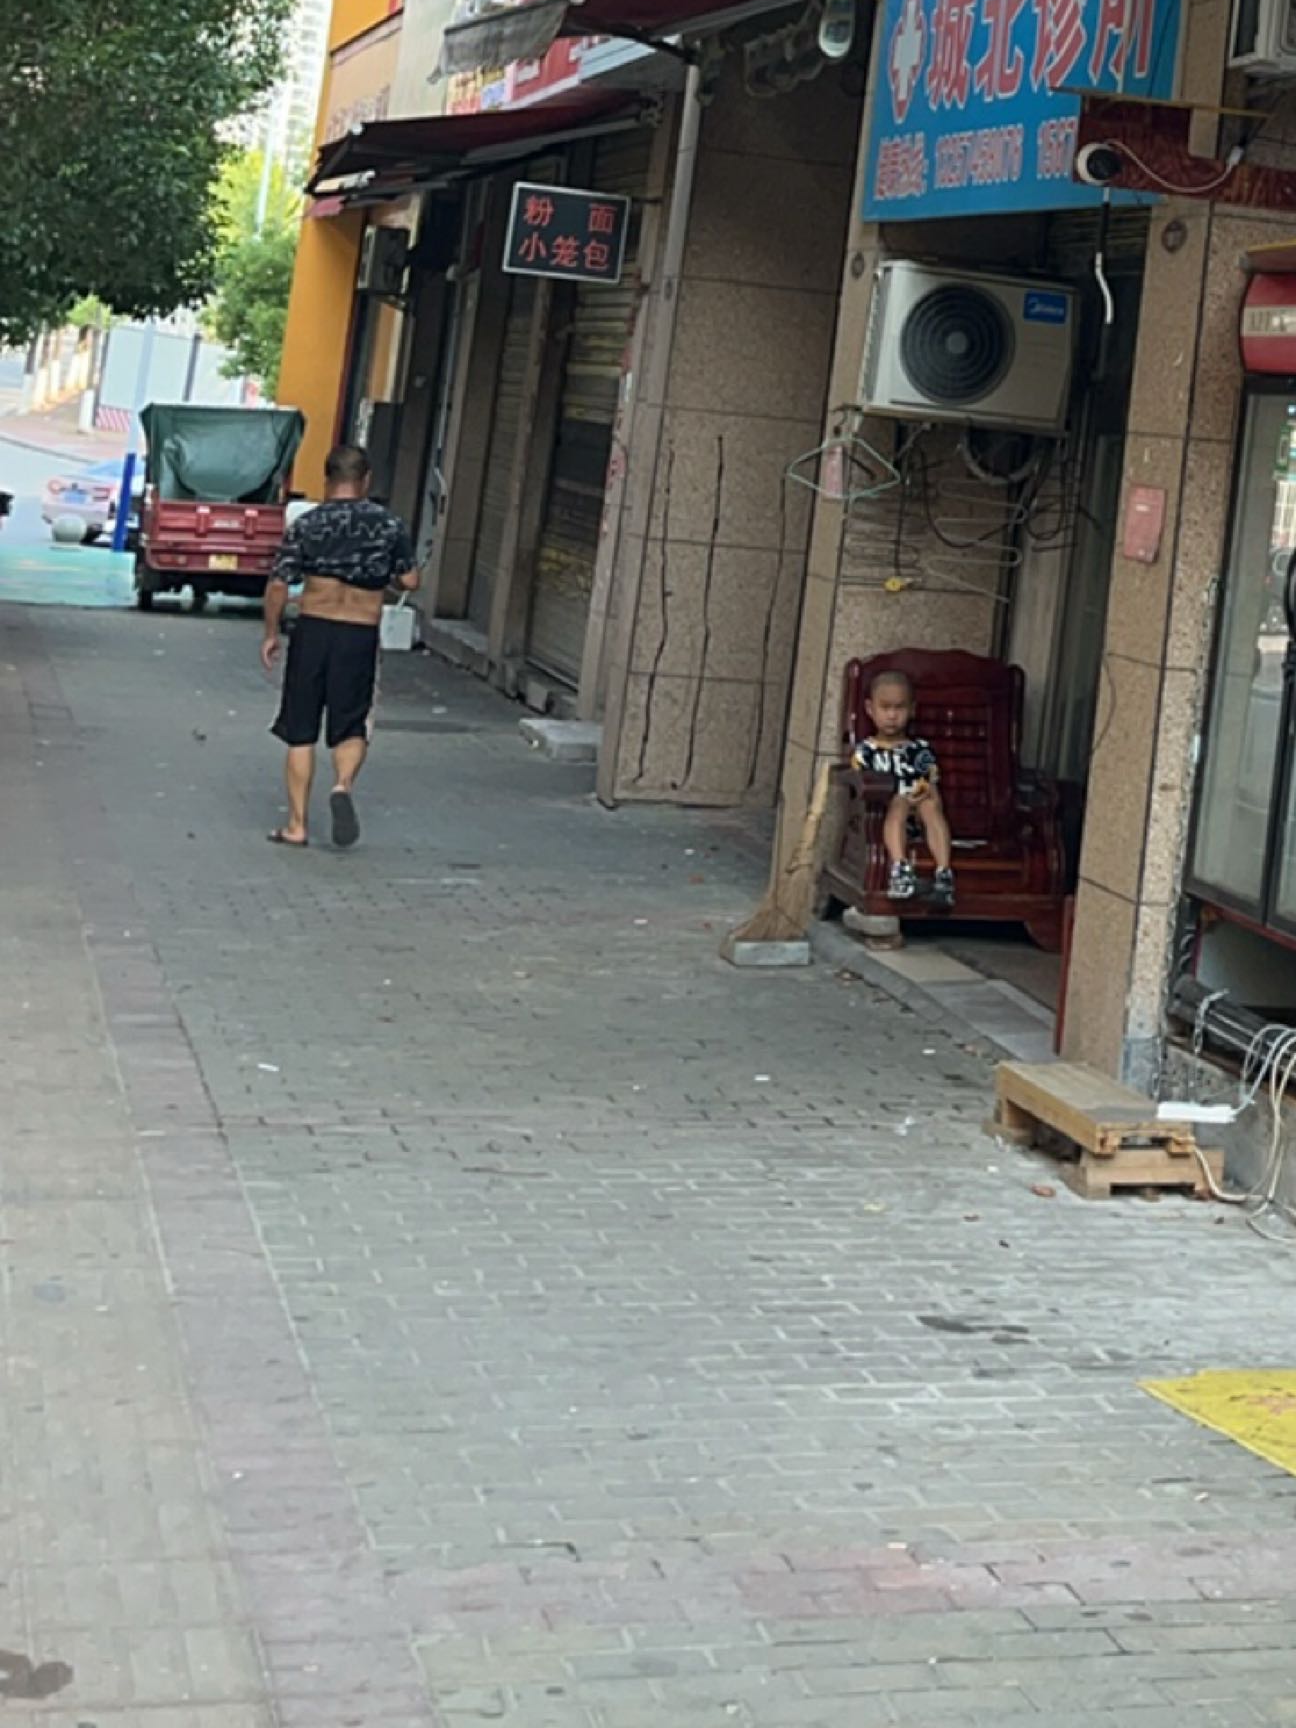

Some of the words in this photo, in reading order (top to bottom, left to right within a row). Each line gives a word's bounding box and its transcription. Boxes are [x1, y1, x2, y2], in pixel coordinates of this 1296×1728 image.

[523, 193, 555, 228] 粉
[588, 202, 617, 234] 面
[517, 231, 610, 271] 小笼包
